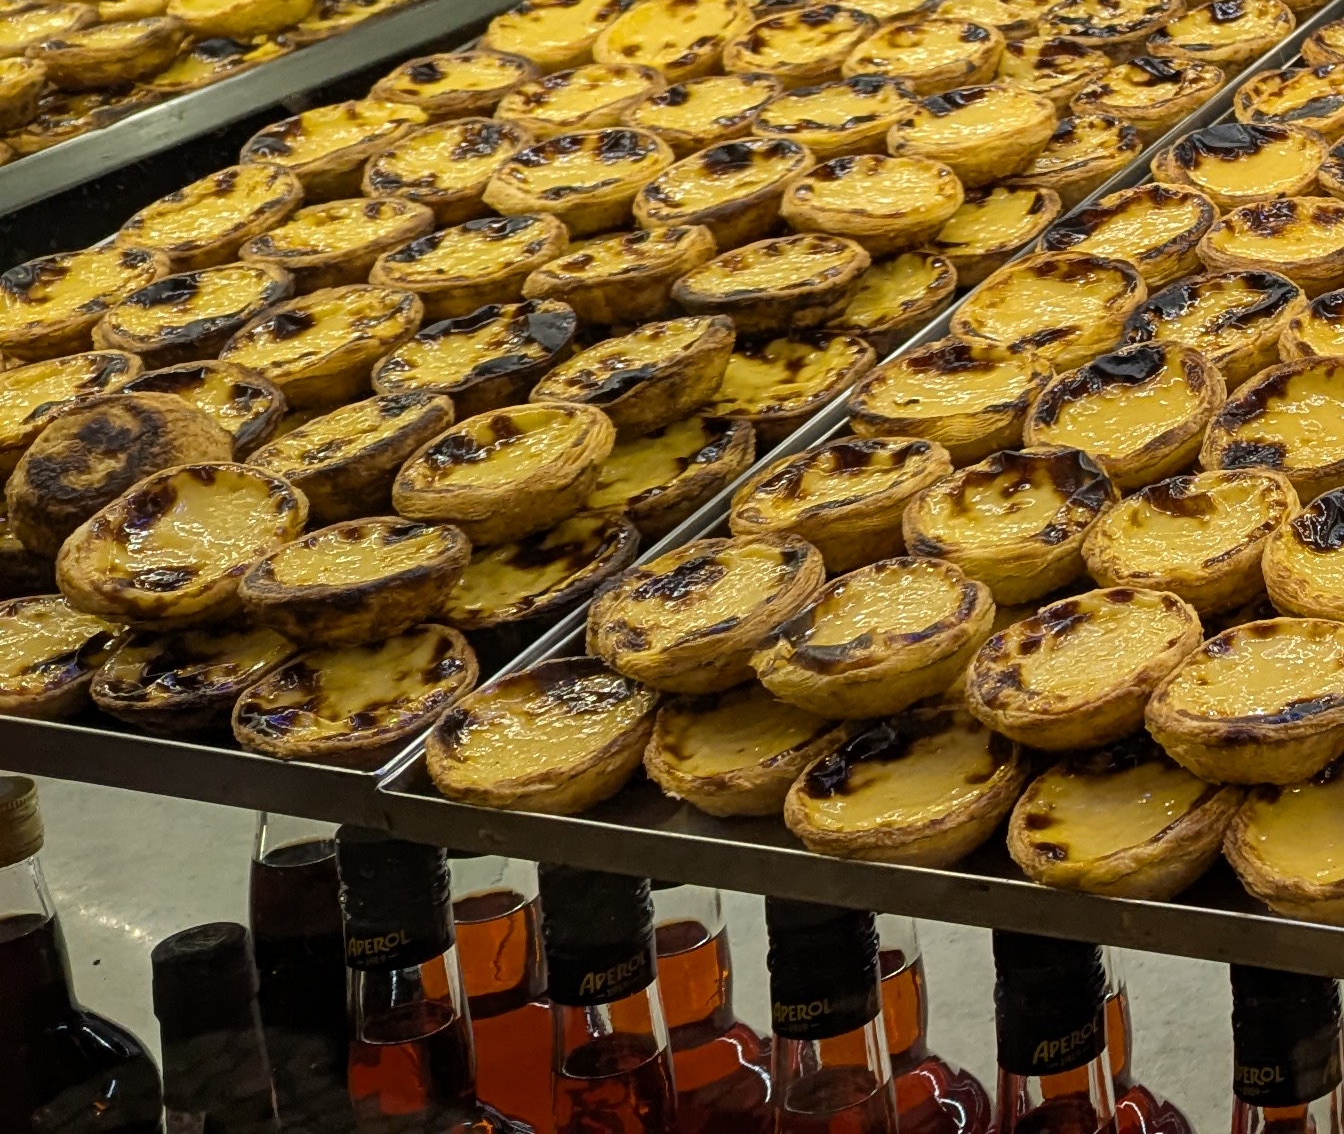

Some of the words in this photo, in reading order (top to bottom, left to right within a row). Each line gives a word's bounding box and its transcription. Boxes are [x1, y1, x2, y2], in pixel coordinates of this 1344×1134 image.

[348, 929, 411, 957] APEROL
[579, 950, 646, 996] APEROL
[774, 998, 833, 1022] APEROL
[1032, 1015, 1099, 1065] APEROL
